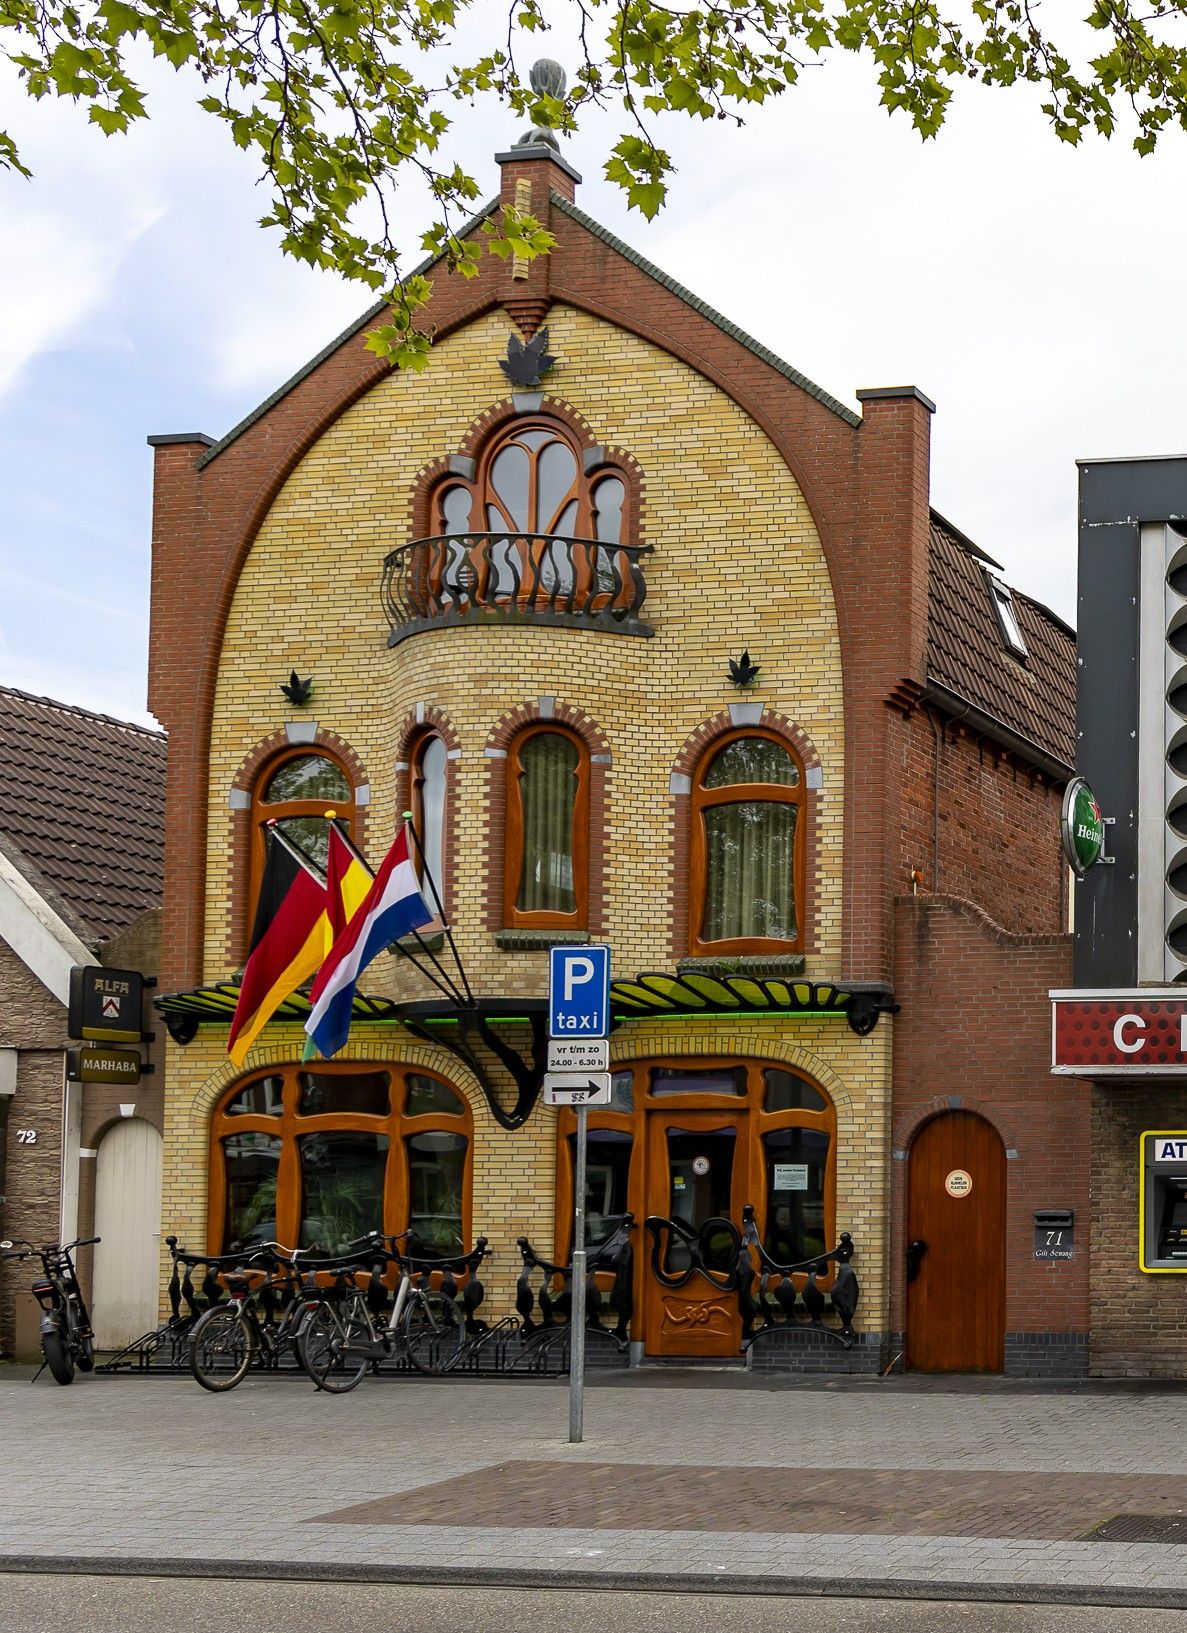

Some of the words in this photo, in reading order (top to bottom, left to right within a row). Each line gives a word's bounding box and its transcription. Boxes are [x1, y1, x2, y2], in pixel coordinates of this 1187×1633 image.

[94, 978, 130, 994] ALFA
[564, 956, 595, 1001] P
[556, 1011, 598, 1029] taxi
[556, 1045, 567, 1054] vr
[569, 1044, 586, 1054] t/m
[588, 1045, 600, 1053] zo
[83, 1058, 137, 1073] MARHABA
[550, 1059, 573, 1067] 24.00
[578, 1059, 595, 1067] 6.30
[597, 1059, 603, 1067] h
[16, 1129, 37, 1144] 72
[1046, 1231, 1063, 1245] 71
